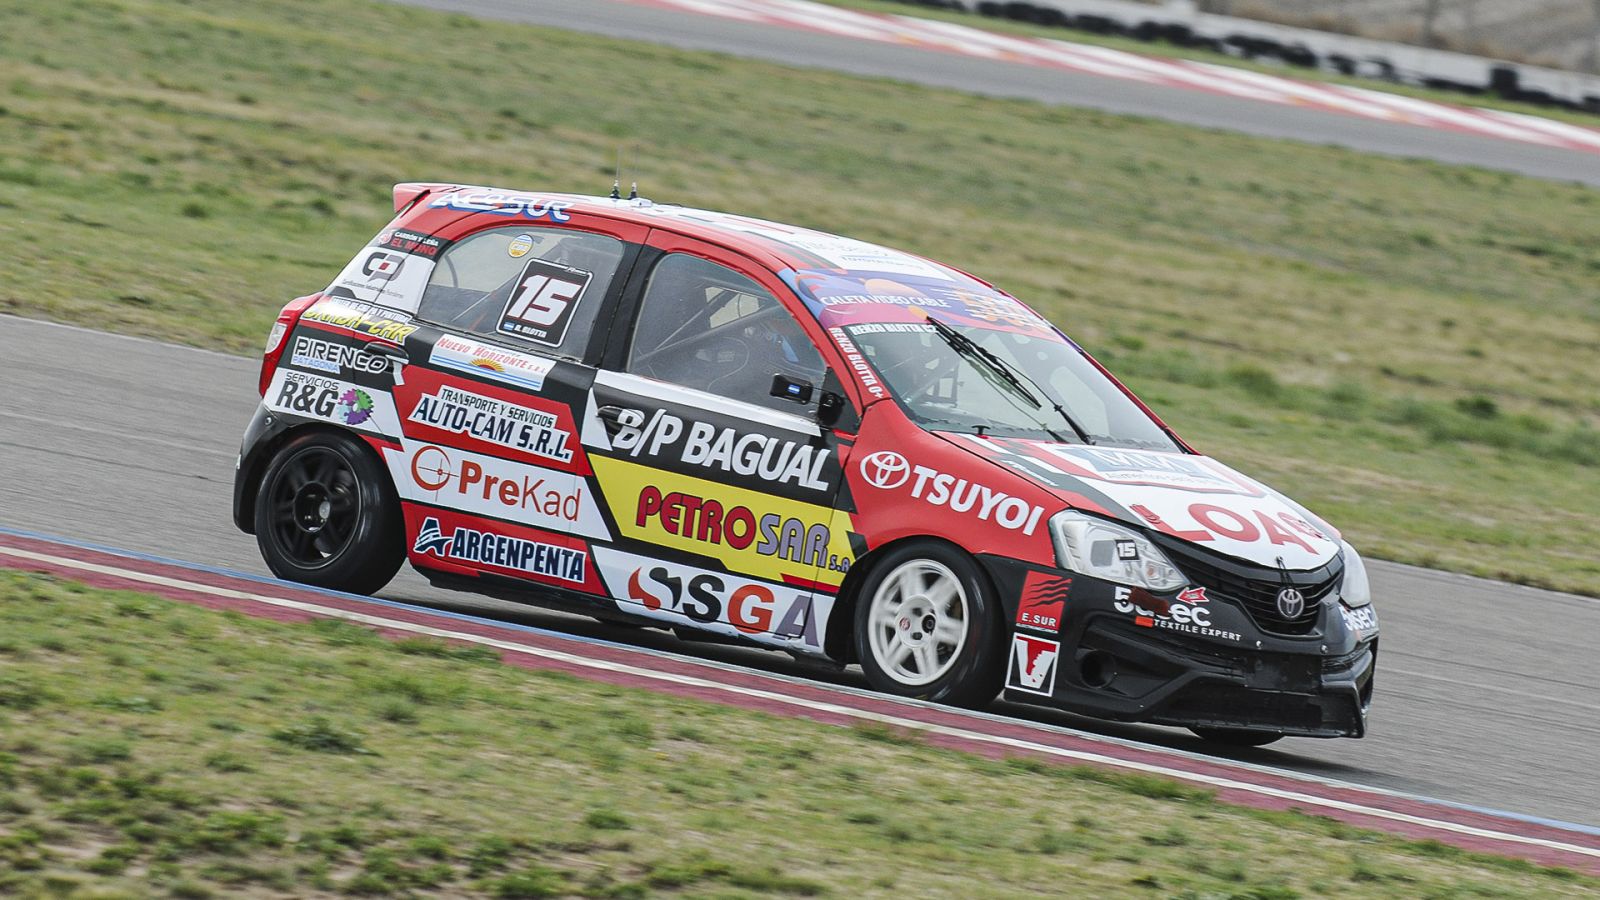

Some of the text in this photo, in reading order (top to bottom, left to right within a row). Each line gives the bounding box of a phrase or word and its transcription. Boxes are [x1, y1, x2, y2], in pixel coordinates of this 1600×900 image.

[390, 237, 403, 248] EL
[504, 273, 583, 326] 15
[820, 295, 952, 308] CALETA VIDEO CABLE
[292, 355, 340, 372] PATAGONIA
[293, 336, 389, 374] PIRENCO
[437, 338, 471, 353] NUEVO
[472, 346, 529, 368] HORIZONTE
[828, 327, 859, 353] RENZO
[847, 354, 878, 386] BLOTTA
[275, 381, 340, 417] R&G
[286, 371, 340, 391] SERVICIOS
[441, 388, 554, 429] TRANSPORTE Y SERVICIOS
[413, 397, 570, 460] AUTO-CAM S.R.L.
[611, 408, 831, 491] B/P BAGUAL
[458, 460, 581, 522] PreKad
[910, 464, 1045, 537] TSUYOI
[635, 485, 831, 569] PETROSAR
[450, 529, 586, 582] ARGENPENTA
[1116, 541, 1137, 560] 15
[1021, 612, 1057, 627] E.SUR
[1154, 619, 1241, 641] TEXTILE EXPERT
